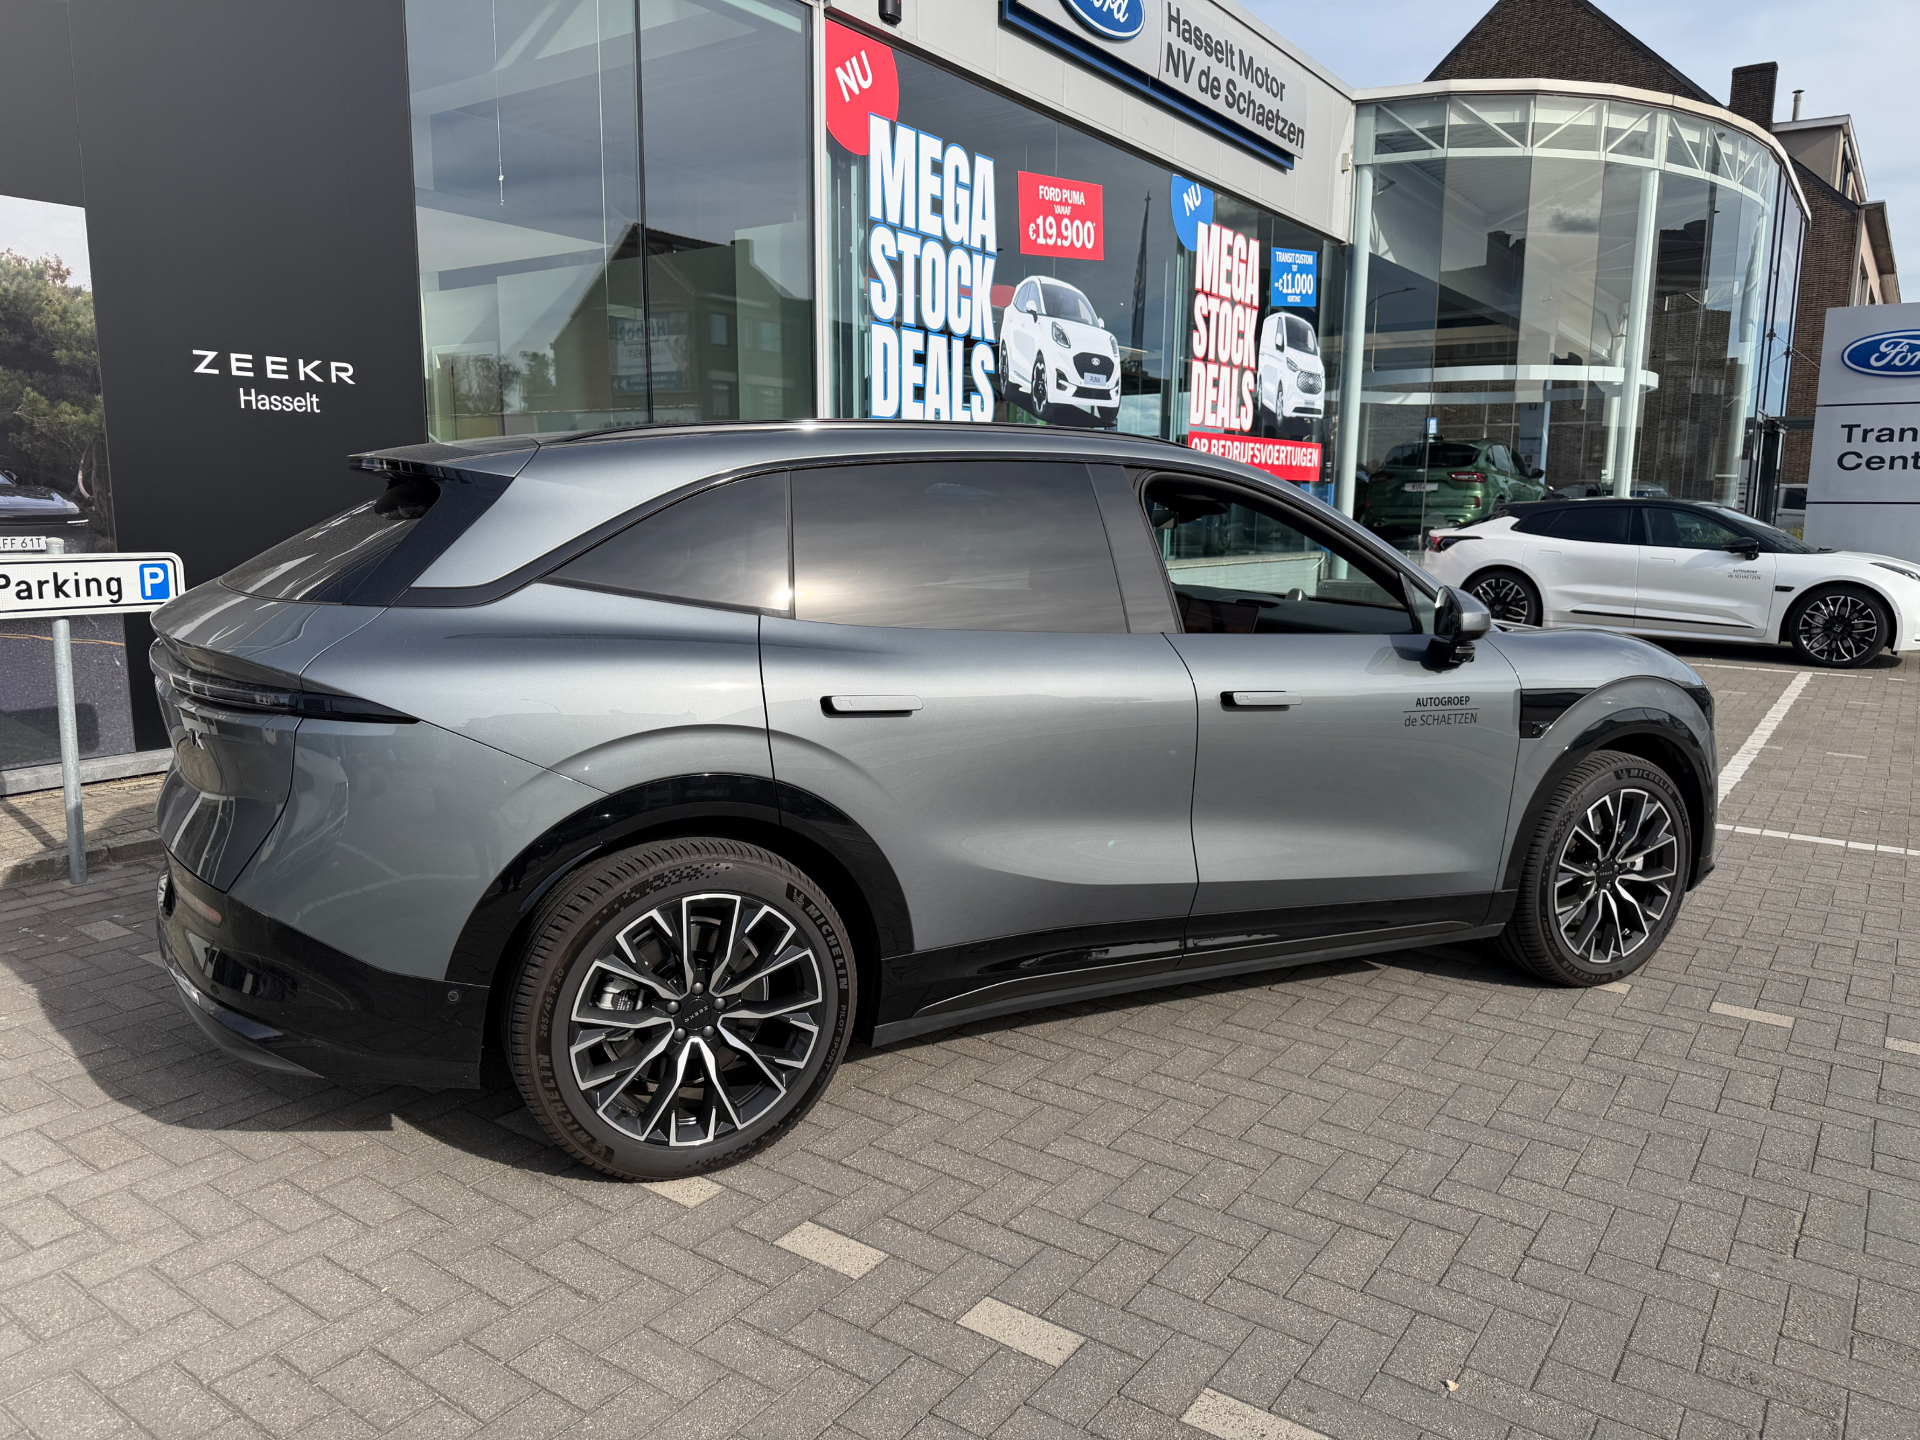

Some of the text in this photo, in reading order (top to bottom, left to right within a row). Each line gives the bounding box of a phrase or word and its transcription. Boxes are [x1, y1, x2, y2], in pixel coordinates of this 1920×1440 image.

[1089, 0, 1129, 23] ord
[1167, 1, 1286, 101] Hasselt Motor
[835, 50, 873, 103] NU
[1165, 41, 1305, 149] NV de Schaetzen
[868, 111, 998, 256] MEGA
[1039, 185, 1086, 206] FORD PUMA
[1182, 183, 1202, 217] NU
[1054, 204, 1072, 216] VANAF
[1194, 221, 1260, 309] MEGA
[1276, 251, 1314, 265] TRANSIT CUSTOM
[869, 224, 998, 344] STOCK
[1192, 292, 1258, 370] STOCK
[192, 350, 356, 385] ZEEKR
[870, 320, 996, 422] DEALS
[240, 388, 320, 413] Hasselt
[1189, 358, 1255, 432] DEALS
[1840, 424, 1918, 444] Tran
[1210, 439, 1320, 468] BEDRIJFSVOERTUIGEN
[1836, 450, 1920, 471] Cent
[21, 538, 41, 548] 61T
[0, 572, 123, 604] Parking
[1415, 696, 1470, 708] AUTOGROEP
[1404, 712, 1478, 727] de SCHAETZEN
[1630, 768, 1674, 796] MICHELIN
[805, 904, 848, 990] MICHELIN
[540, 968, 564, 1038] 265/45 R 20
[838, 1004, 847, 1034] PILOT
[825, 1036, 841, 1070] SPORT
[538, 1054, 592, 1144] MICHELIN
